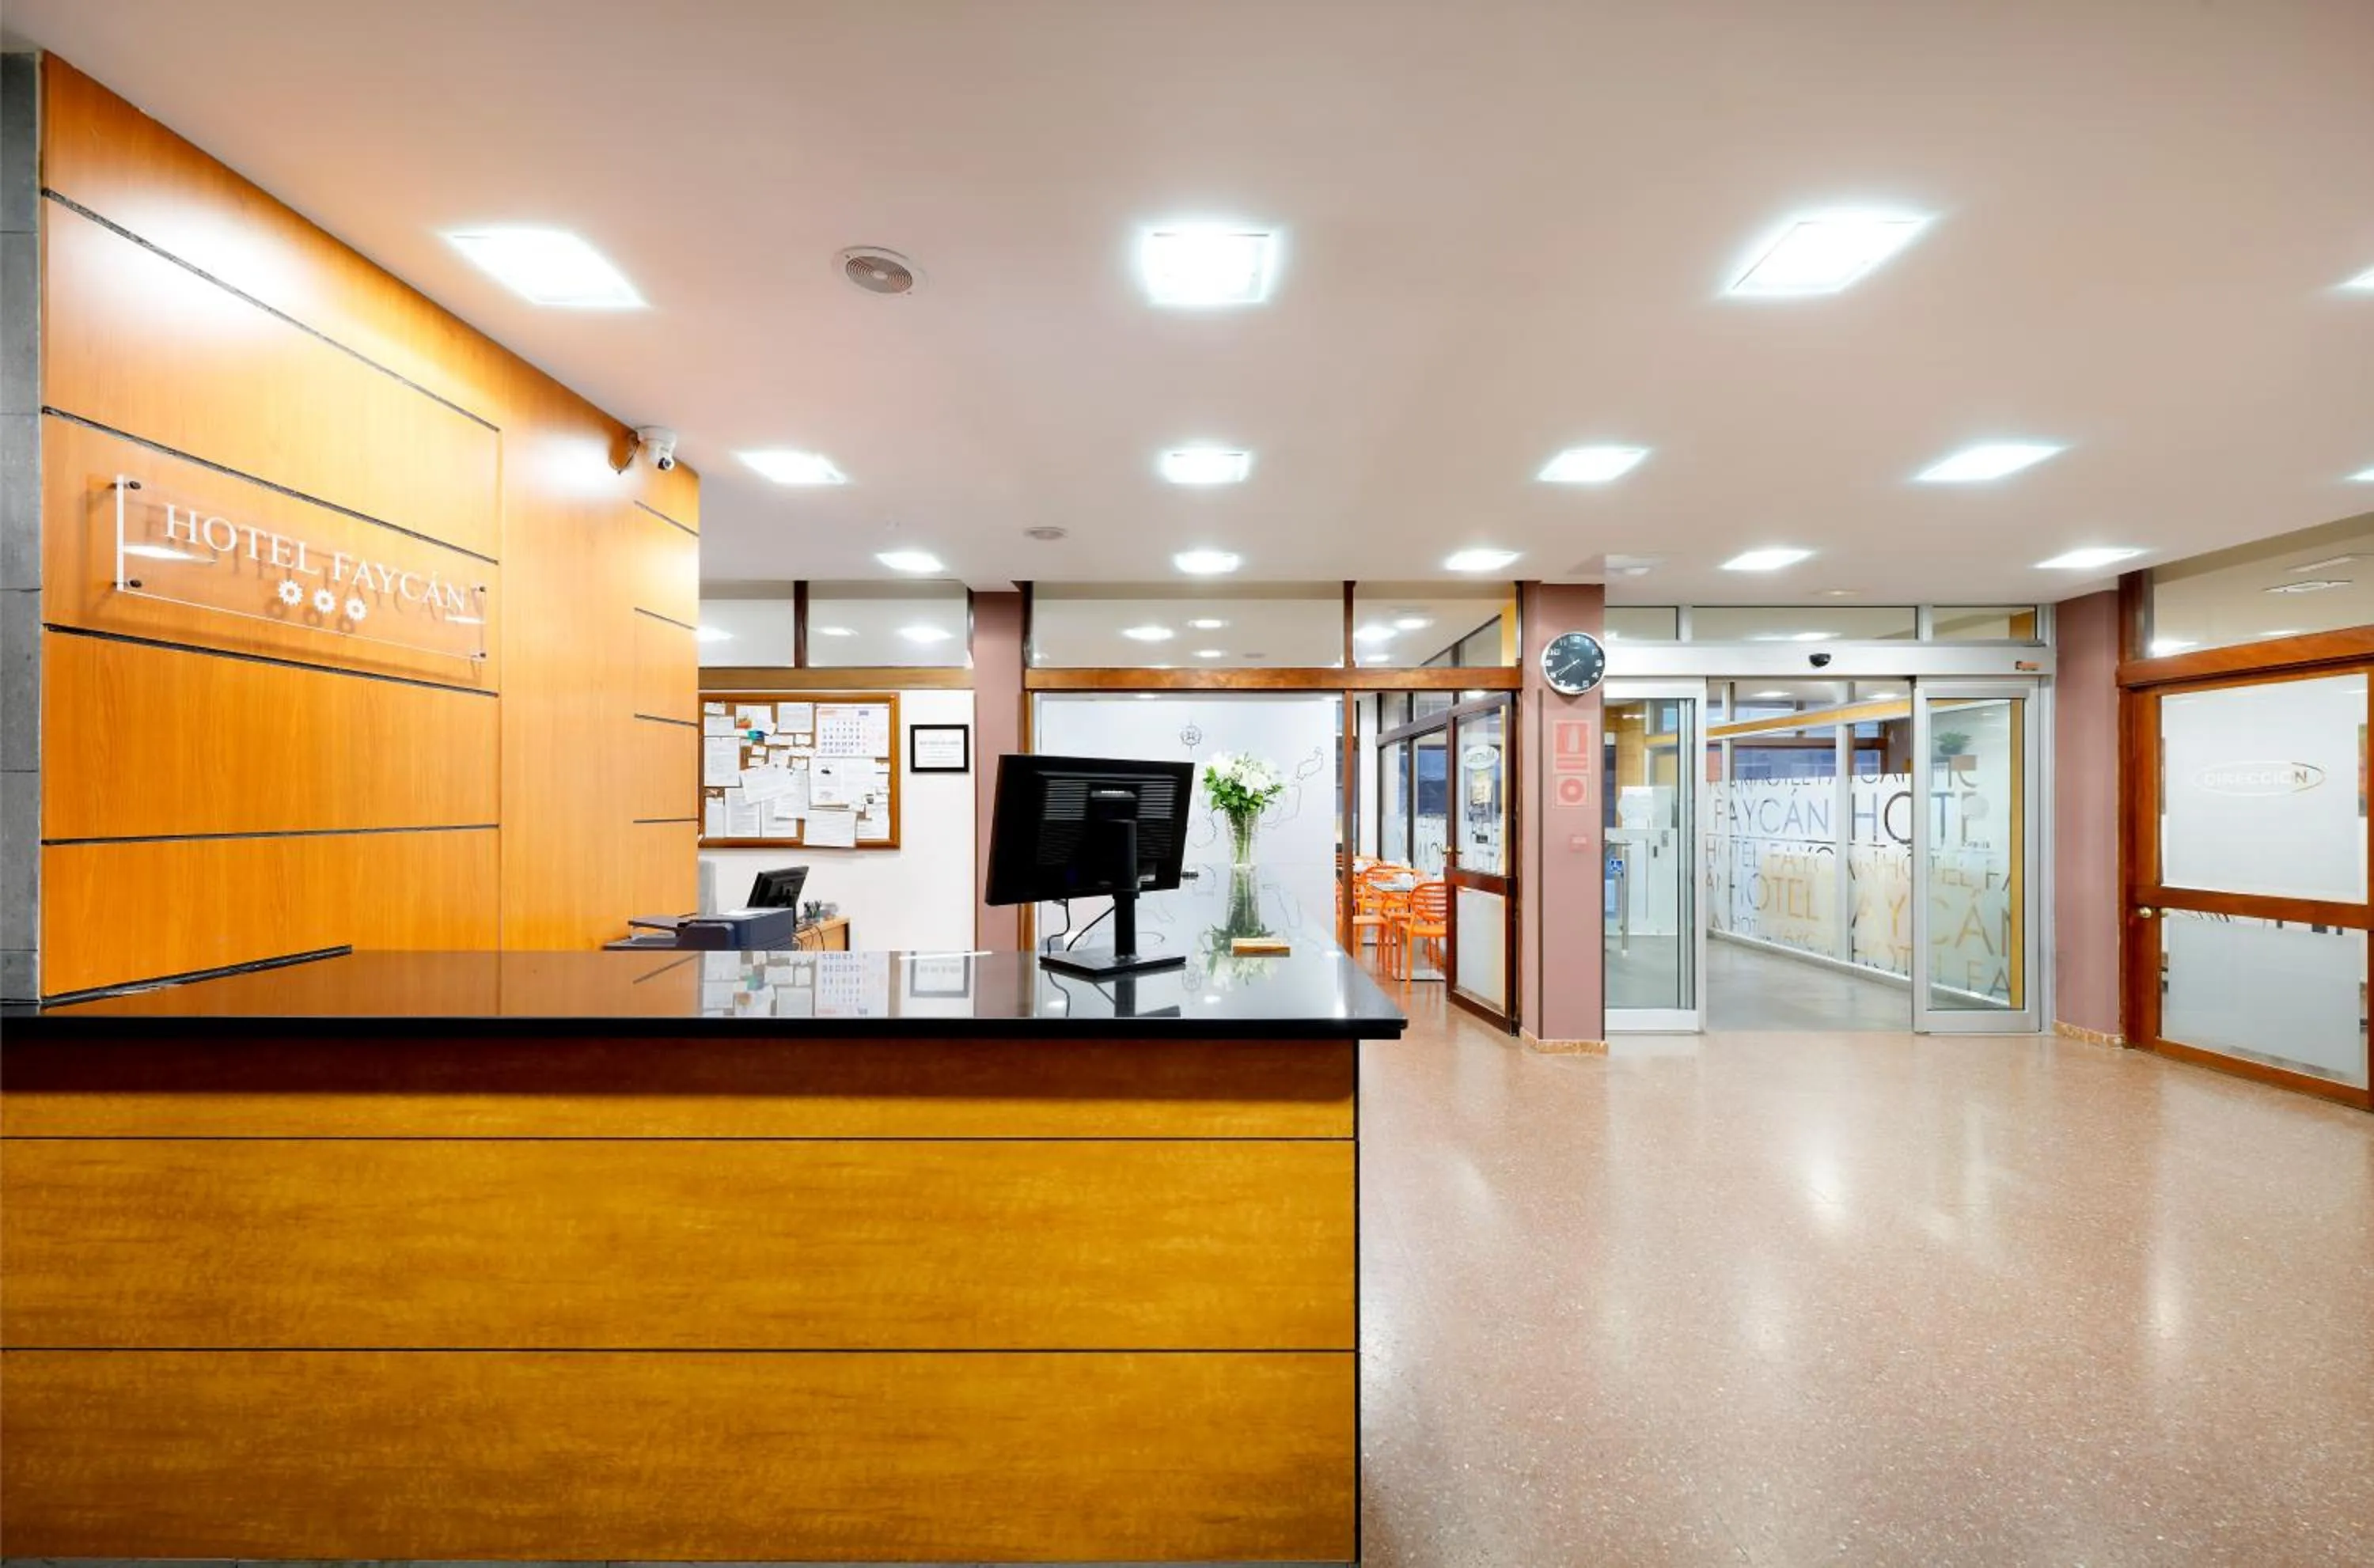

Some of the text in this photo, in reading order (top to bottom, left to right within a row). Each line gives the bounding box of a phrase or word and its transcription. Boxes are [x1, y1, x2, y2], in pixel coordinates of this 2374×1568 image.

[162, 503, 465, 609] HOTEL FAYCÁN
[1714, 788, 1829, 835] FAYCÁN
